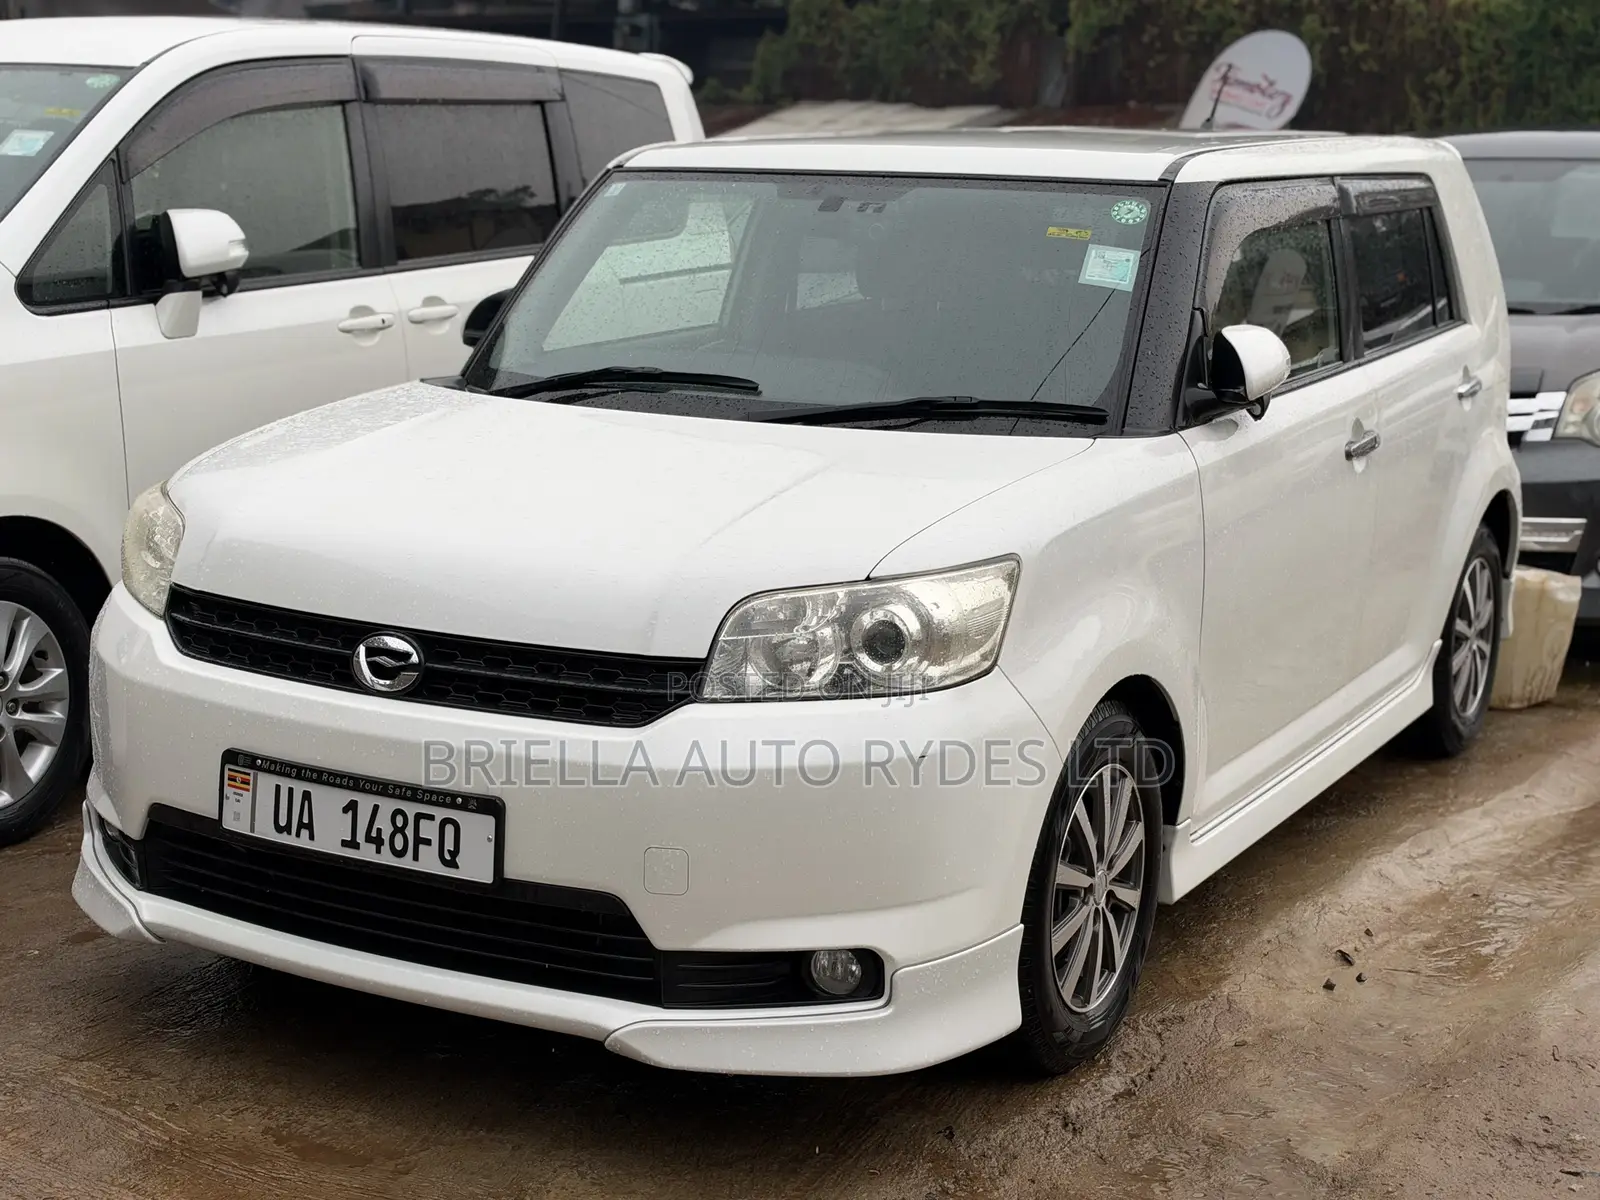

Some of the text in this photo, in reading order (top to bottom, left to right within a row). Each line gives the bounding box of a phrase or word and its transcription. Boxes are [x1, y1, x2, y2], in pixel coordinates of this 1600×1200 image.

[261, 759, 452, 804] Making the Roads Your Safe Space
[273, 783, 461, 870] UA 148FQ
